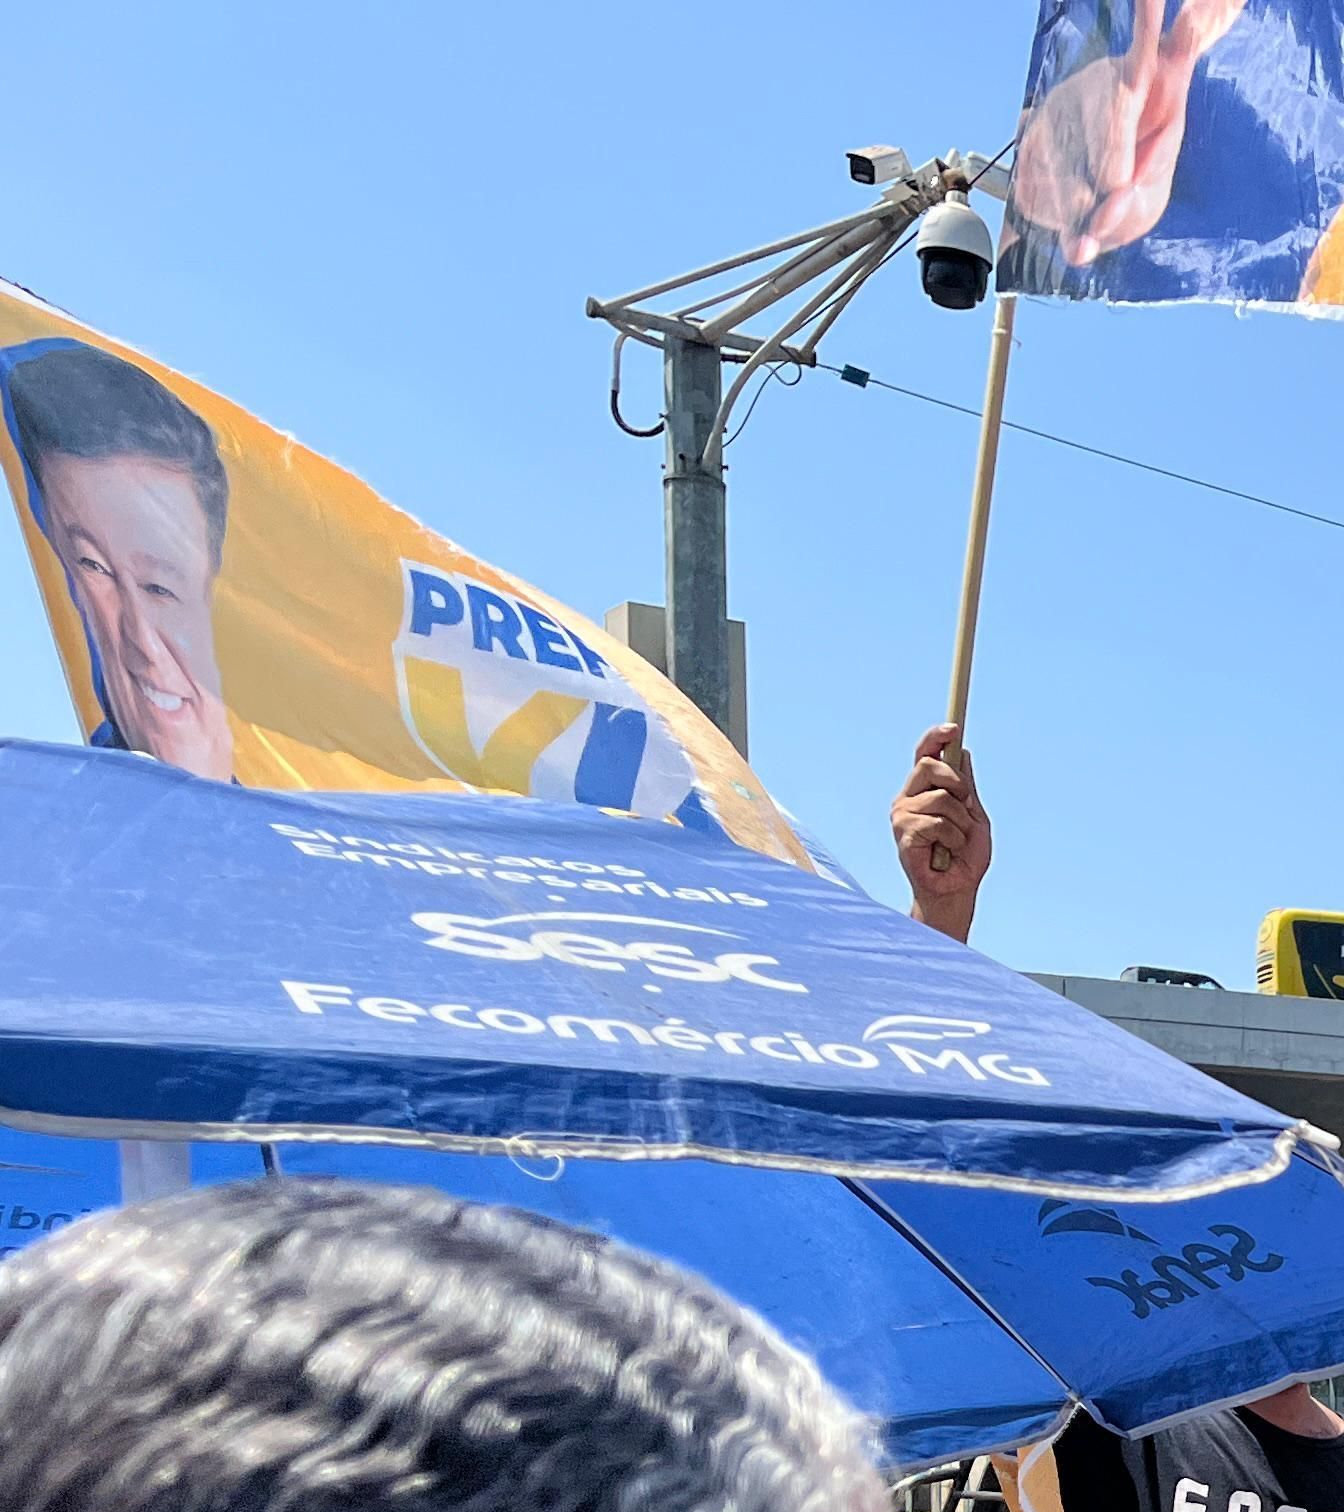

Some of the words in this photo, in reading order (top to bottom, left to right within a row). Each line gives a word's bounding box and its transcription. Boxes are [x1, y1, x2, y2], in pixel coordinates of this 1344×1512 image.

[268, 823, 646, 878] Sindicatos
[292, 840, 769, 907] Empresariais
[280, 980, 880, 1069] Fecomércio
[887, 1042, 1052, 1087] MG
